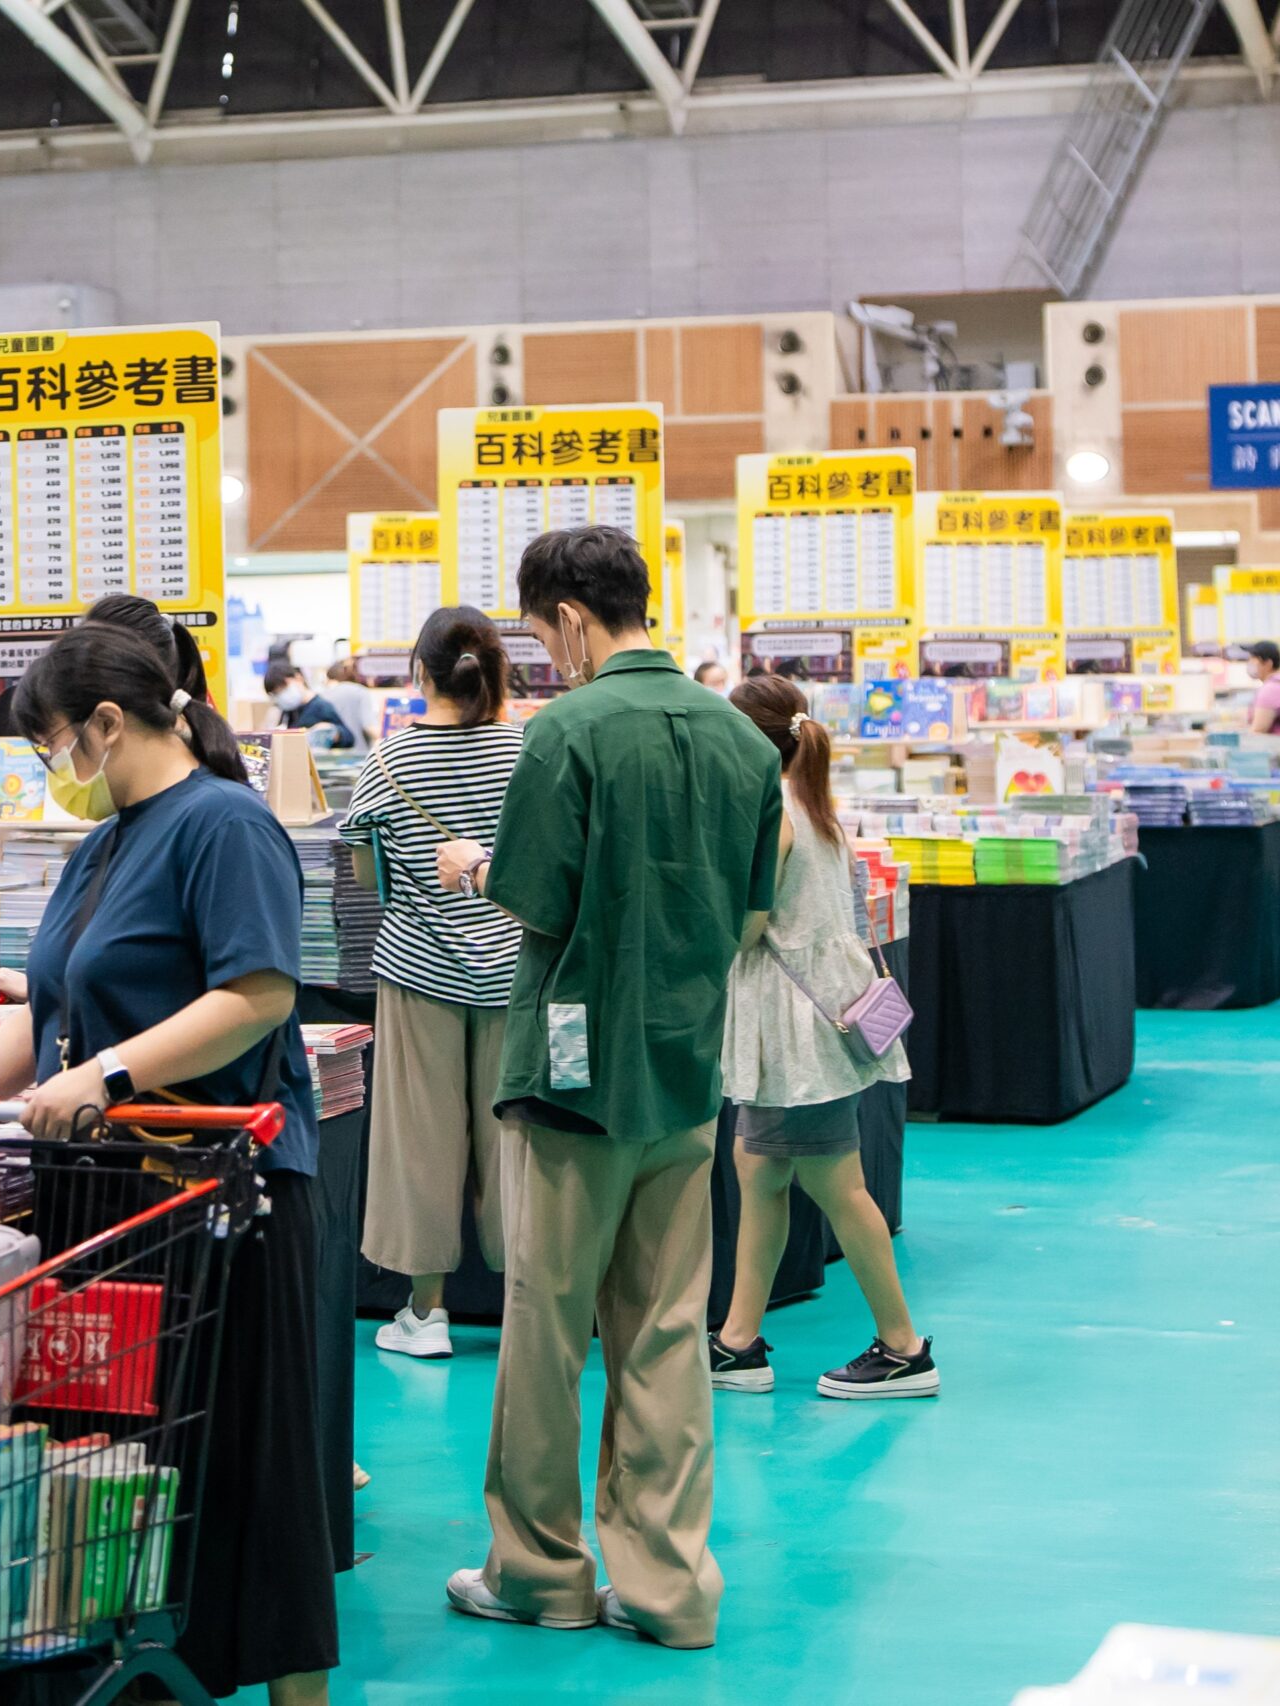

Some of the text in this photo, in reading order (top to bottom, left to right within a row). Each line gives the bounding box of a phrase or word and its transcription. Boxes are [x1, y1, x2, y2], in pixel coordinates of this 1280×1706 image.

[1228, 400, 1280, 431] SCAN
[475, 427, 660, 466] 百科參考書
[768, 469, 912, 500] 百科參考書
